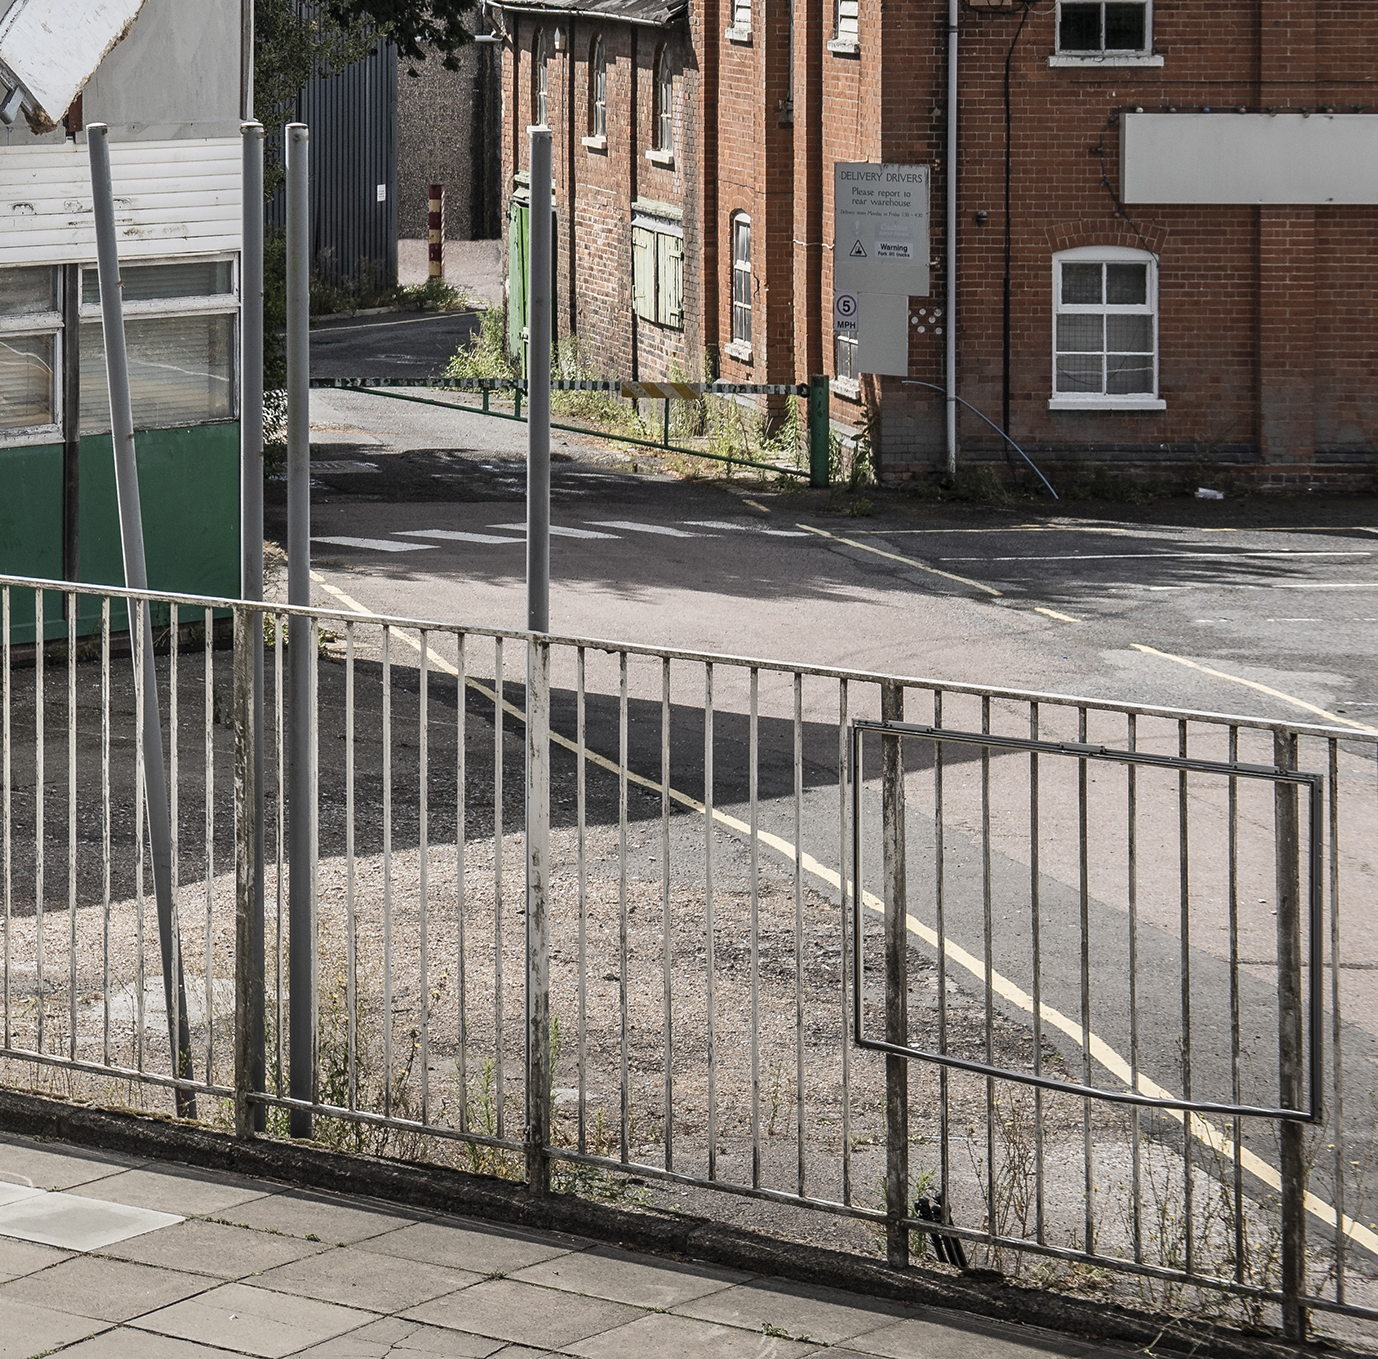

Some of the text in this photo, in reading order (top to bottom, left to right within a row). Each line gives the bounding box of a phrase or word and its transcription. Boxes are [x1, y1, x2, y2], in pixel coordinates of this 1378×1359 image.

[840, 171, 923, 183] DELIVERY DRIVERS
[851, 186, 875, 196] Please
[877, 190, 900, 198] report
[870, 198, 911, 207] warehouse
[880, 243, 908, 252] Warning
[842, 300, 851, 312] 5
[837, 321, 856, 329] MPH
